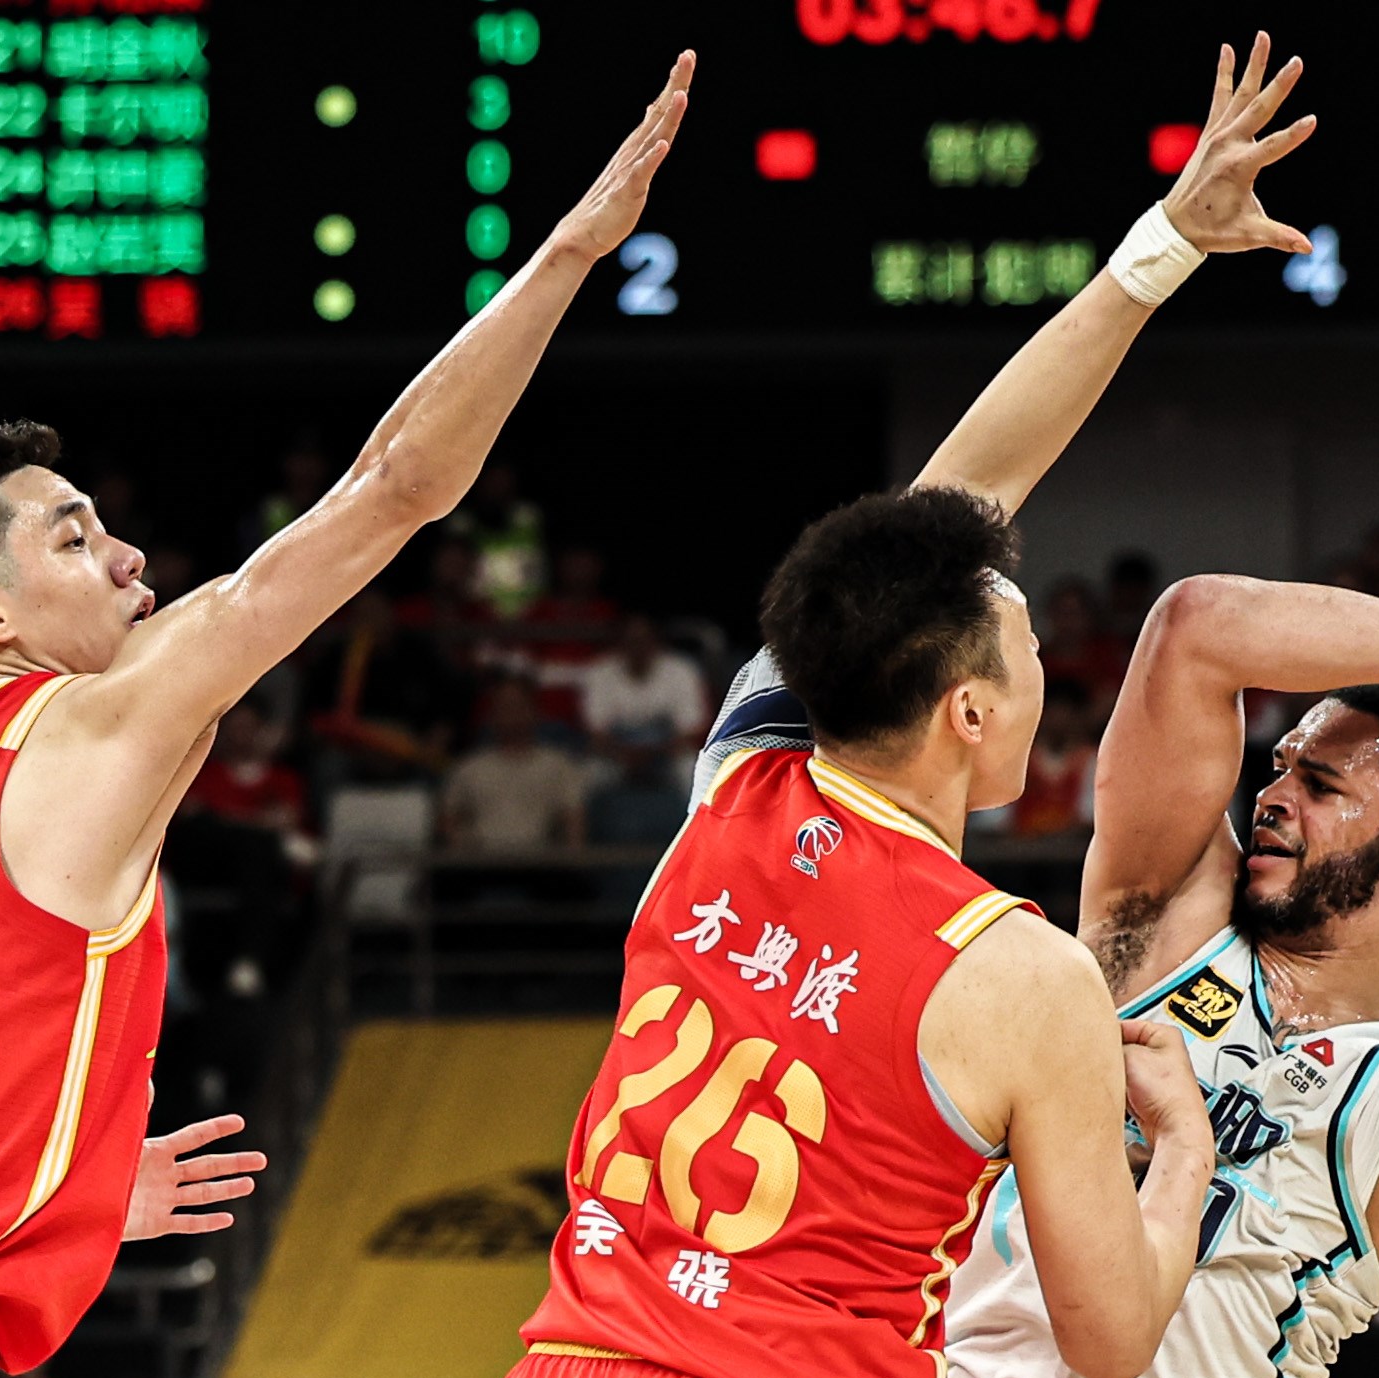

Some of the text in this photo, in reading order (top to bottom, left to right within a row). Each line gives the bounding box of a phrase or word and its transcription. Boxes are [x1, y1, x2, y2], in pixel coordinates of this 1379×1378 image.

[618, 232, 680, 315] 2
[1283, 1053, 1328, 1090] 广发银行
[1284, 1068, 1310, 1094] CGB
[574, 984, 827, 1255] 26
